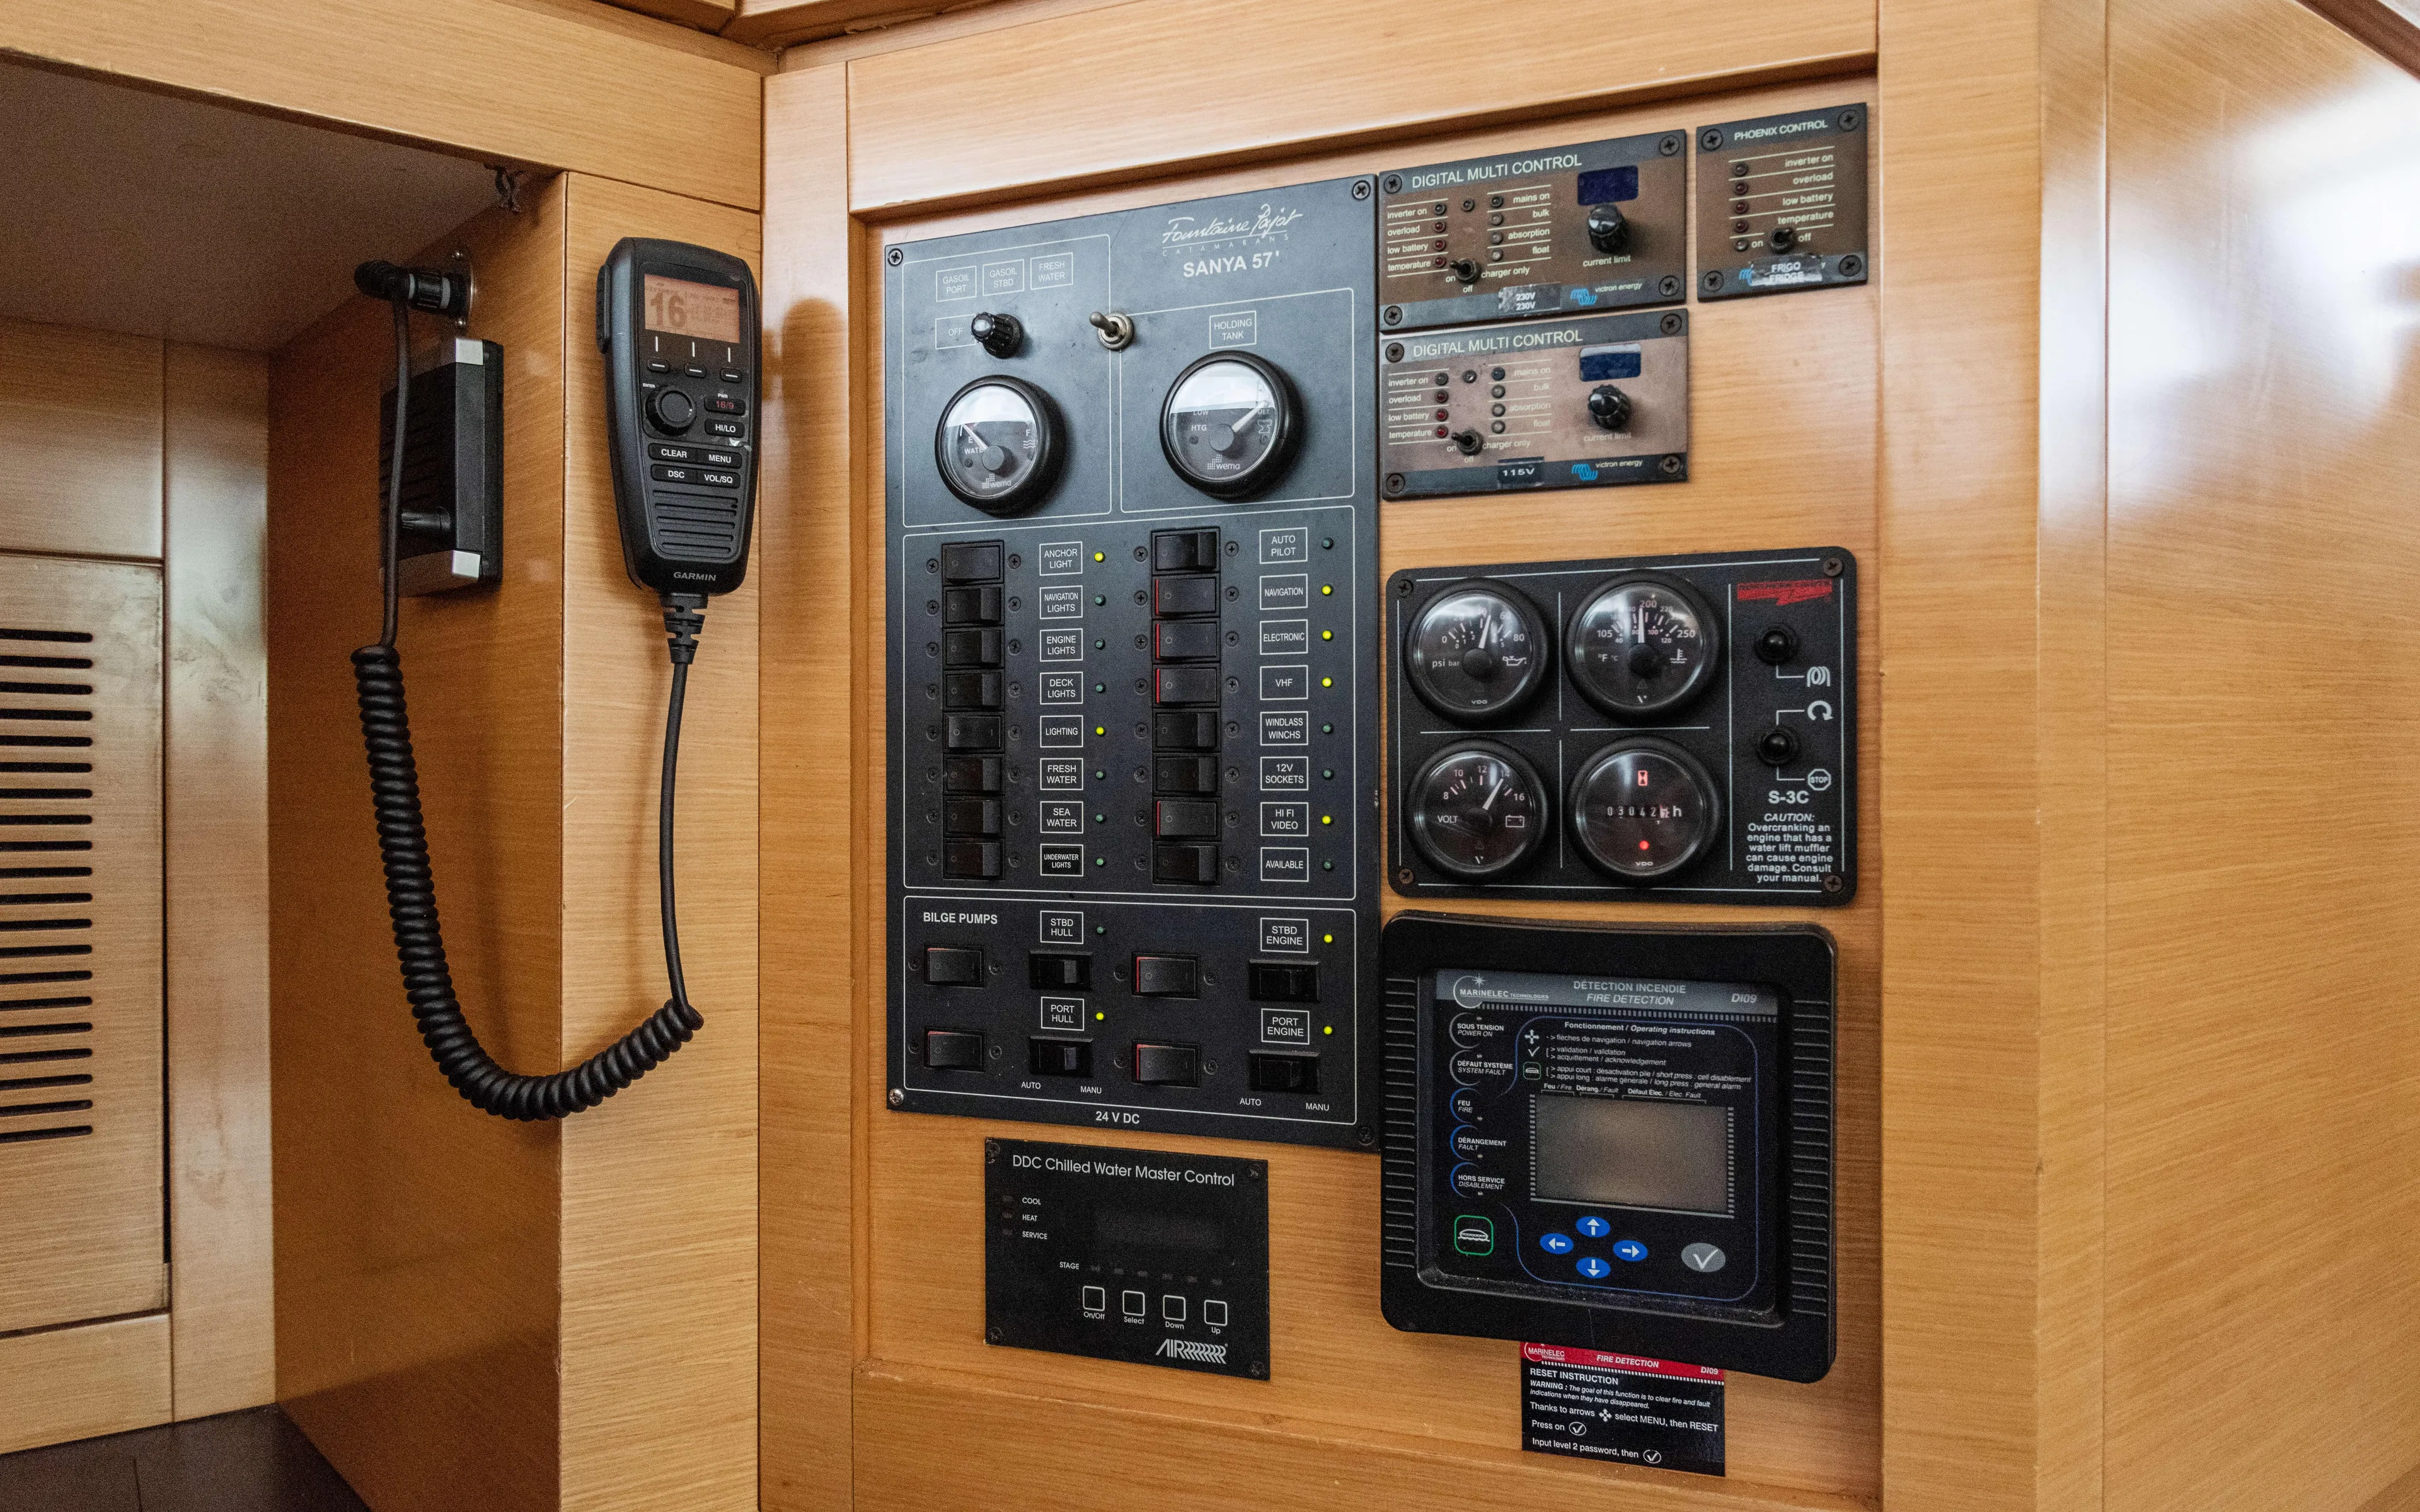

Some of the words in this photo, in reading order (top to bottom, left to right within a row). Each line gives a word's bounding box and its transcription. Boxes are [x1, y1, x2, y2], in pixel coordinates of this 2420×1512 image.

[1734, 126, 1778, 142] PHOENIX
[1778, 119, 1828, 135] CONTROL
[1412, 169, 1464, 189] DIGITAL
[1467, 163, 1509, 181] MULTI
[1512, 154, 1582, 176] CONTROL
[1512, 193, 1535, 204] mains
[1537, 192, 1550, 201] on
[1782, 197, 1799, 207] low
[1799, 192, 1834, 205] battery
[1386, 208, 1415, 220] inverter
[1417, 207, 1427, 216] on
[1387, 225, 1420, 236] overload
[1387, 244, 1401, 255] low
[1402, 242, 1429, 254] battery
[1182, 256, 1247, 279] SANYA
[1252, 250, 1281, 271] 57'
[1582, 256, 1613, 268] current
[1613, 253, 1631, 264] limit
[1038, 260, 1065, 272] FRESH
[1387, 259, 1432, 273] temperature
[1771, 261, 1801, 273] FRIGO
[988, 267, 1018, 279] GASOIL
[1037, 271, 1066, 282] WATER
[1480, 268, 1511, 281] charger
[1512, 265, 1531, 277] only
[942, 273, 971, 285] GASOIL
[993, 278, 1014, 288] STBD
[945, 283, 967, 295] PORT
[1515, 291, 1536, 302] 230V
[650, 292, 686, 329] 16
[1516, 301, 1536, 311] 230V
[1213, 318, 1253, 331] HOLDING
[947, 326, 964, 337] OFF
[1221, 329, 1245, 341] TANK
[1413, 340, 1465, 358] DIGITAL
[1468, 336, 1509, 352] MULTI
[1512, 329, 1584, 348] CONTROL
[715, 400, 735, 411] 16/9
[715, 423, 737, 434] HI/LO
[660, 448, 688, 459] CLEAR
[708, 453, 732, 464] MENU
[1214, 460, 1241, 472] wema
[667, 469, 685, 479] DSC
[1502, 466, 1535, 478] 115V
[703, 473, 734, 485] VOL/SQ
[1271, 535, 1296, 545] AUTO
[1044, 548, 1078, 559] ANCHOR
[1270, 547, 1296, 557] PILOT
[1049, 559, 1073, 570] LIGHT
[672, 571, 717, 582] GARMIN
[1044, 592, 1079, 602] NAVIGATION
[1264, 587, 1303, 597] NAVIGATION
[1047, 604, 1076, 614] LIGHTS
[1263, 633, 1305, 643] ELECTRONIC
[1512, 633, 1525, 643] 80
[1596, 629, 1613, 639] 105
[1676, 629, 1696, 639] 250
[1046, 635, 1076, 644] ENGINE
[1047, 646, 1076, 656] LIGHTS
[1431, 658, 1446, 670] psi
[1049, 678, 1074, 687] DECK
[1275, 679, 1293, 687] VHF
[1047, 690, 1076, 699] LIGHTS
[1265, 718, 1303, 727] WINDLASS
[1045, 728, 1078, 736] LIGHTING
[1268, 730, 1301, 740] WINCHS
[1047, 765, 1077, 774] FRESH
[1275, 764, 1294, 772] 12V
[1477, 765, 1487, 774] 12
[1046, 776, 1077, 784] WATER
[1265, 775, 1305, 784] SOCKETS
[1809, 776, 1829, 784] STOP
[1767, 791, 1810, 804] S-3C
[1052, 808, 1071, 816] SEA
[1275, 808, 1285, 818] HI
[1286, 808, 1294, 818] FI
[1437, 815, 1458, 823] VOLT
[1763, 813, 1815, 822] CAUTION:
[1046, 818, 1077, 828] WATER
[1270, 821, 1299, 830] VIDEO
[1748, 823, 1816, 833] Overcranking
[1043, 853, 1079, 861] UNDERWATER
[1265, 860, 1304, 869] AVAILABLE
[1747, 863, 1790, 874] damage.
[1792, 863, 1831, 873] Consult
[1756, 874, 1780, 884] your
[1782, 873, 1823, 882] manual.
[923, 912, 956, 924] BILGE
[959, 913, 998, 925] PUMPS
[1050, 918, 1074, 927] STBD
[1050, 927, 1073, 937] HULL
[1271, 925, 1298, 935] STBD
[1265, 936, 1303, 946] ENGINE
[1460, 988, 1510, 998] MARINELEC
[1635, 983, 1686, 995] INCENDIE
[1586, 993, 1616, 1003] FIRE
[1616, 994, 1674, 1006] DETECTION
[1731, 992, 1758, 1004] DI09
[1050, 1004, 1075, 1014] PORT
[1051, 1014, 1074, 1024] HULL
[1272, 1016, 1299, 1026] PORT
[1267, 1026, 1305, 1037] ENGINE
[1475, 1023, 1504, 1031] TENSION
[1020, 1080, 1041, 1090] AUTO
[1080, 1085, 1102, 1094] MANU
[1239, 1097, 1262, 1106] AUTO
[1305, 1102, 1330, 1111] MANU
[1095, 1110, 1110, 1122] 24
[1111, 1111, 1120, 1123] V
[1122, 1113, 1140, 1125] DC
[1458, 1136, 1507, 1147] DÉRANGEMENT
[1012, 1154, 1042, 1169] DDC
[1045, 1158, 1092, 1174] Chilled
[1093, 1162, 1132, 1177] Water
[1135, 1165, 1181, 1182] Master
[1184, 1171, 1235, 1187] Control
[1477, 1176, 1506, 1184] SERVICE
[1022, 1197, 1042, 1206] COOL
[1022, 1213, 1038, 1222] HEAT
[1022, 1230, 1048, 1240] SERVICE
[1059, 1261, 1080, 1270] STAGE
[1083, 1311, 1105, 1320] On/Off
[1123, 1316, 1144, 1325] Select
[1165, 1321, 1185, 1330] Down
[1211, 1326, 1221, 1335] Up
[1596, 1354, 1615, 1363] FIRE
[1615, 1356, 1659, 1368] DETECTION
[1700, 1366, 1719, 1375] DI09
[1530, 1367, 1559, 1378] RESET
[1559, 1370, 1619, 1385] INSTRUCTION
[1530, 1401, 1558, 1412] Thanks
[1559, 1404, 1568, 1413] to
[1569, 1407, 1596, 1417] arrows
[1615, 1412, 1639, 1423] select
[1639, 1415, 1669, 1427] MENU,
[1669, 1419, 1688, 1429] then
[1689, 1421, 1719, 1433] RESET
[1531, 1419, 1553, 1429] Press
[1554, 1423, 1565, 1431] on
[1532, 1436, 1552, 1448] Input
[1553, 1440, 1571, 1450] level
[1572, 1442, 1578, 1450] 2
[1579, 1443, 1620, 1457] password,
[1621, 1448, 1639, 1458] then
